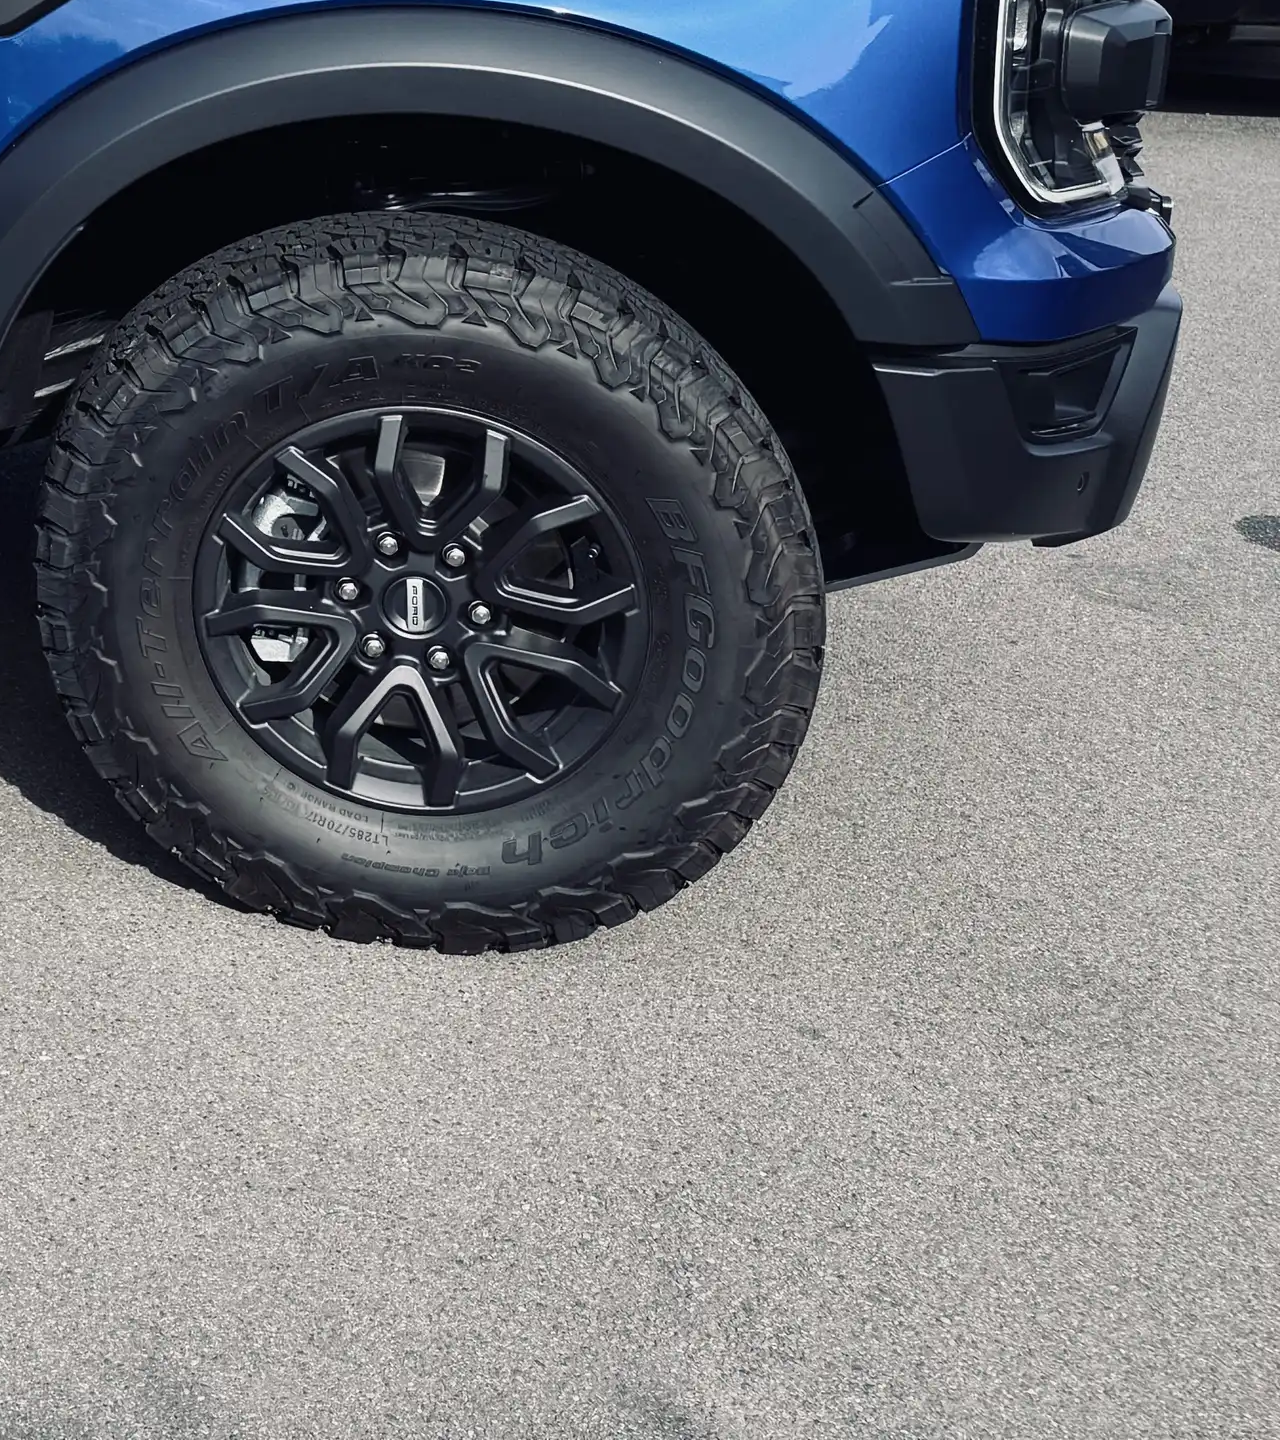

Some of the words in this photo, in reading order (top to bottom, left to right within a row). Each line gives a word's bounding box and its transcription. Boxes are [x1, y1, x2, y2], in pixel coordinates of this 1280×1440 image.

[136, 411, 252, 762] All-Terrain
[252, 356, 380, 412] T/A
[502, 497, 716, 866] BFGoodrich
[341, 852, 440, 878] Champion
